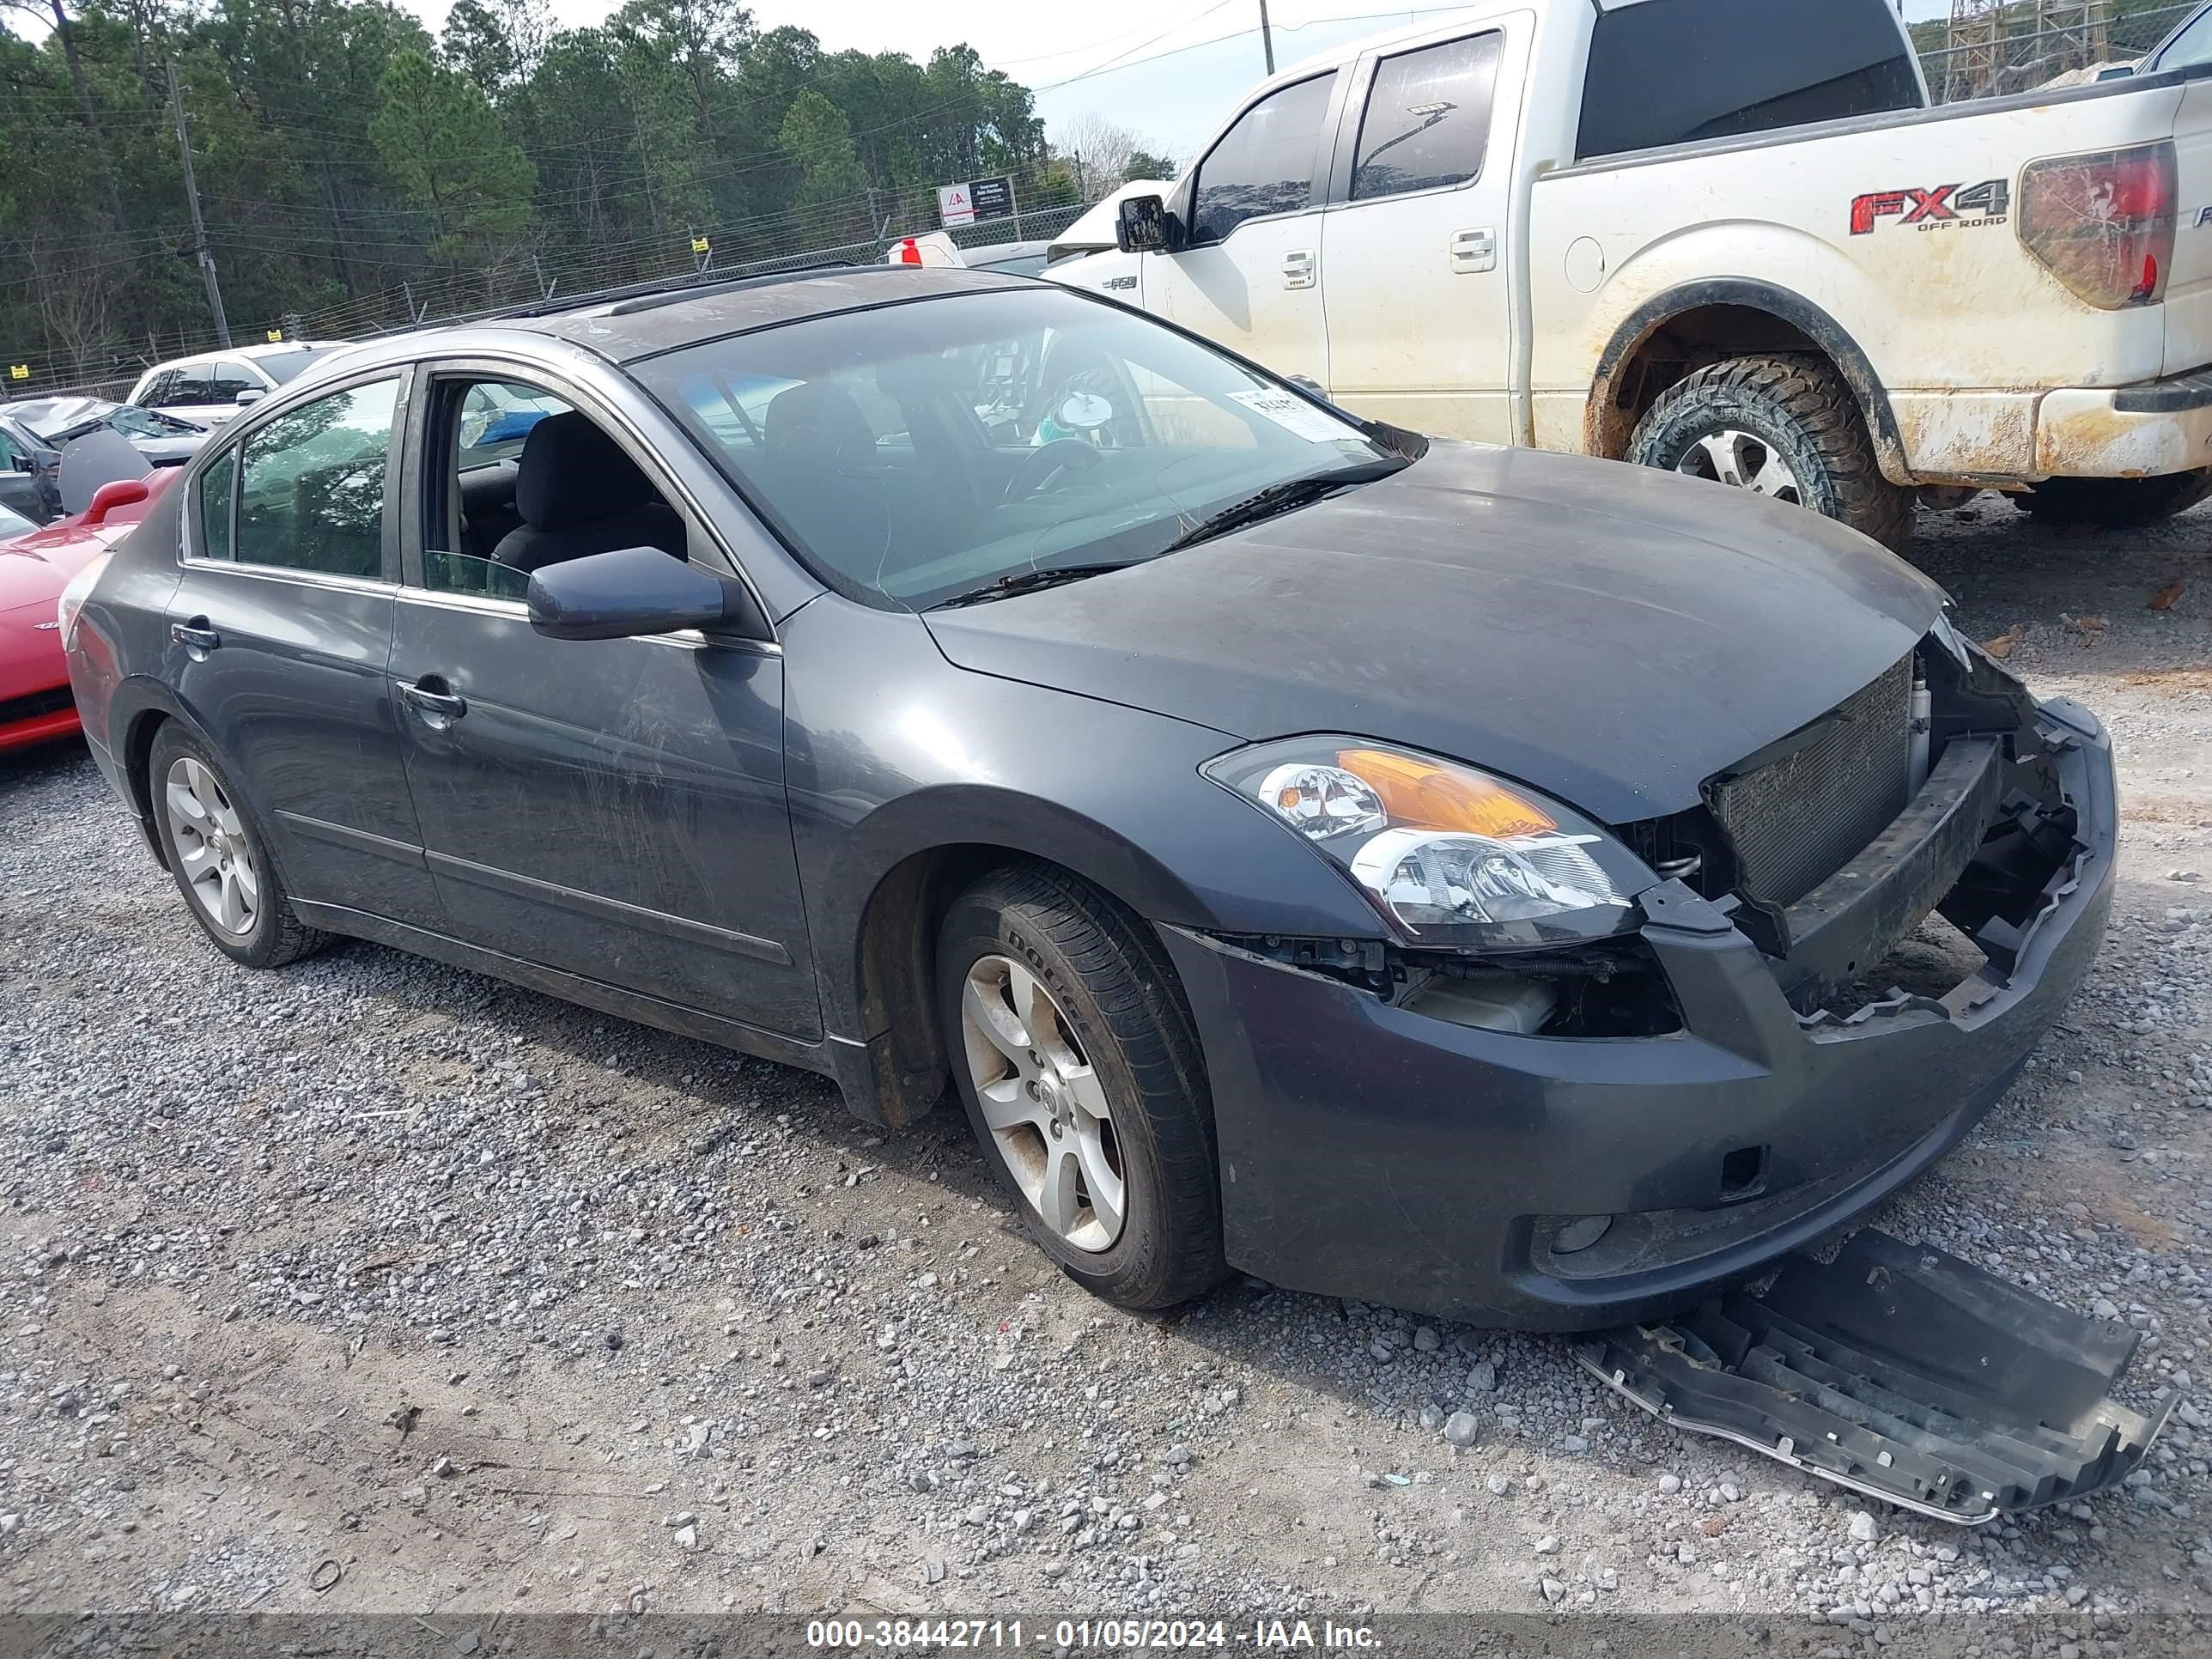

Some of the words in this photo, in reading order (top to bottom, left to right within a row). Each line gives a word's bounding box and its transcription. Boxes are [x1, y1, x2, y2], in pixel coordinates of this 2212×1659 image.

[1850, 178, 2010, 236] FX4
[1917, 222, 1952, 232] OFF
[1959, 216, 2007, 228] ROAD
